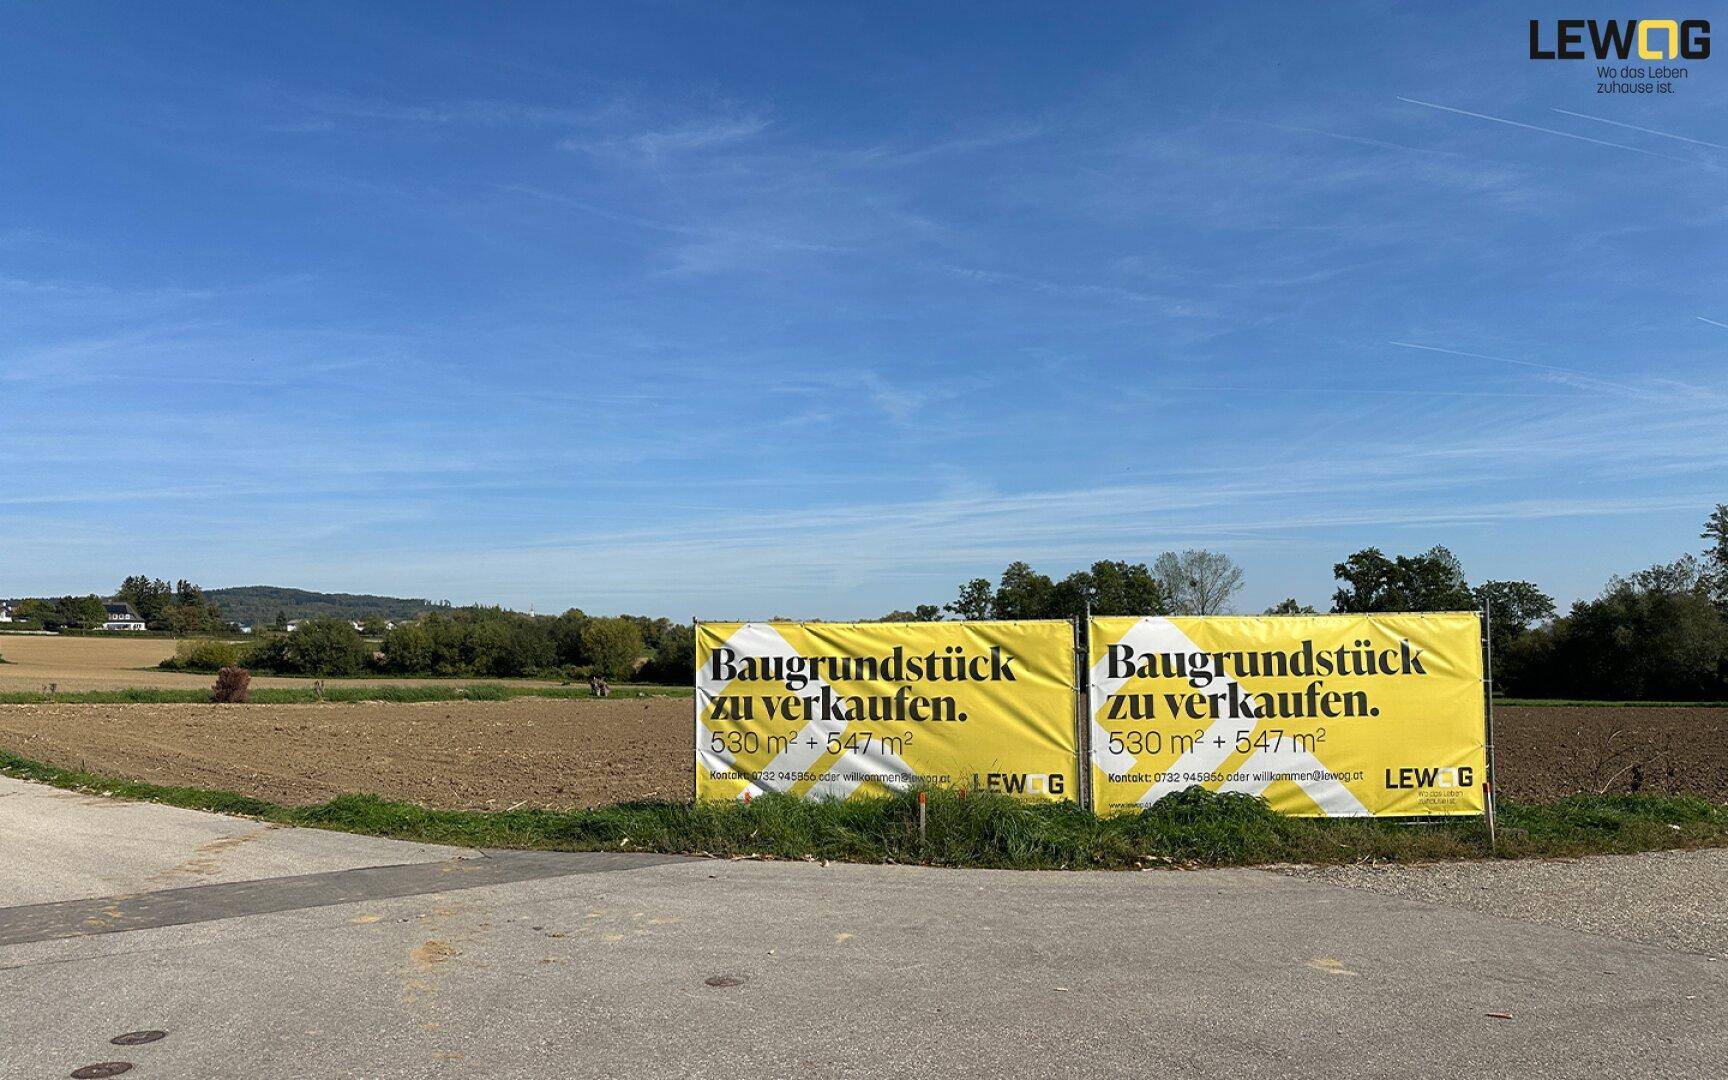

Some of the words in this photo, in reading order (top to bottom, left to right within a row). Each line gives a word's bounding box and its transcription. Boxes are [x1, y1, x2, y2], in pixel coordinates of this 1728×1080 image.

[711, 646, 1016, 691] Baugrundstück
[1107, 639, 1427, 688] Baugrundstück
[710, 695, 754, 721] zu
[762, 685, 968, 722] verkaufen.
[1106, 693, 1155, 720] zu
[1164, 680, 1380, 719] verkaufen.
[710, 731, 759, 754] 530
[806, 736, 818, 749] +
[826, 731, 873, 755] 547
[1108, 730, 1162, 755] 530
[1213, 735, 1226, 749] +
[1235, 729, 1284, 754] 547
[752, 771, 775, 781] 0732
[1108, 772, 1151, 783] Kontakt:
[1154, 772, 1180, 783] 0732
[1183, 772, 1224, 782] 945856
[1227, 771, 1250, 782] oder
[1252, 770, 1364, 782] willkommen@lewog.at
[1385, 766, 1473, 789] LEWOG
